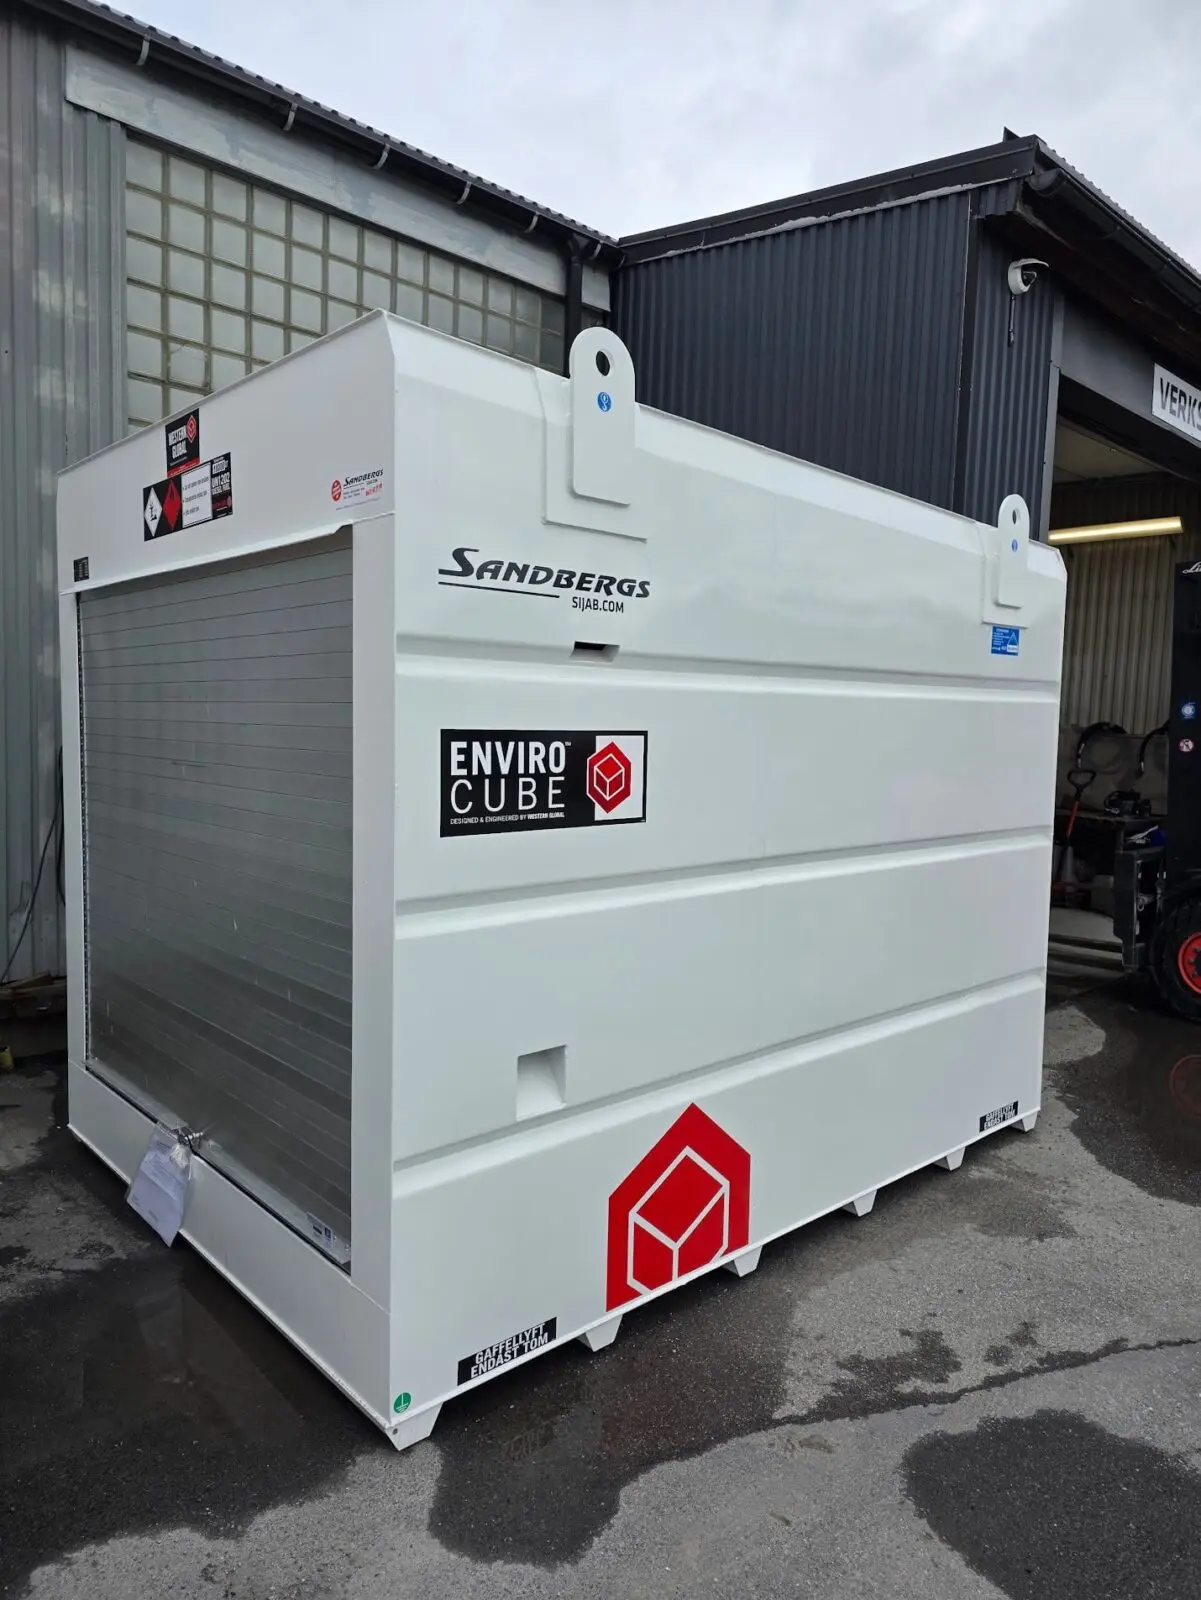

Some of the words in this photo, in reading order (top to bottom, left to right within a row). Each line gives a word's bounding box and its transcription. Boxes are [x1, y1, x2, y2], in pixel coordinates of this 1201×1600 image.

[343, 469, 384, 488] SANDBERGS
[438, 547, 650, 598] SANDBERGS
[572, 596, 624, 613] SIJAB.COM
[450, 741, 566, 776] ENVIRO
[450, 776, 565, 814] CUBE
[450, 816, 479, 825] DESIGNED
[485, 814, 519, 823] ENGINEERED
[470, 1345, 520, 1379] ENDAST
[523, 1332, 549, 1353] TOM
[475, 1322, 546, 1364] GAFFELLYFT
